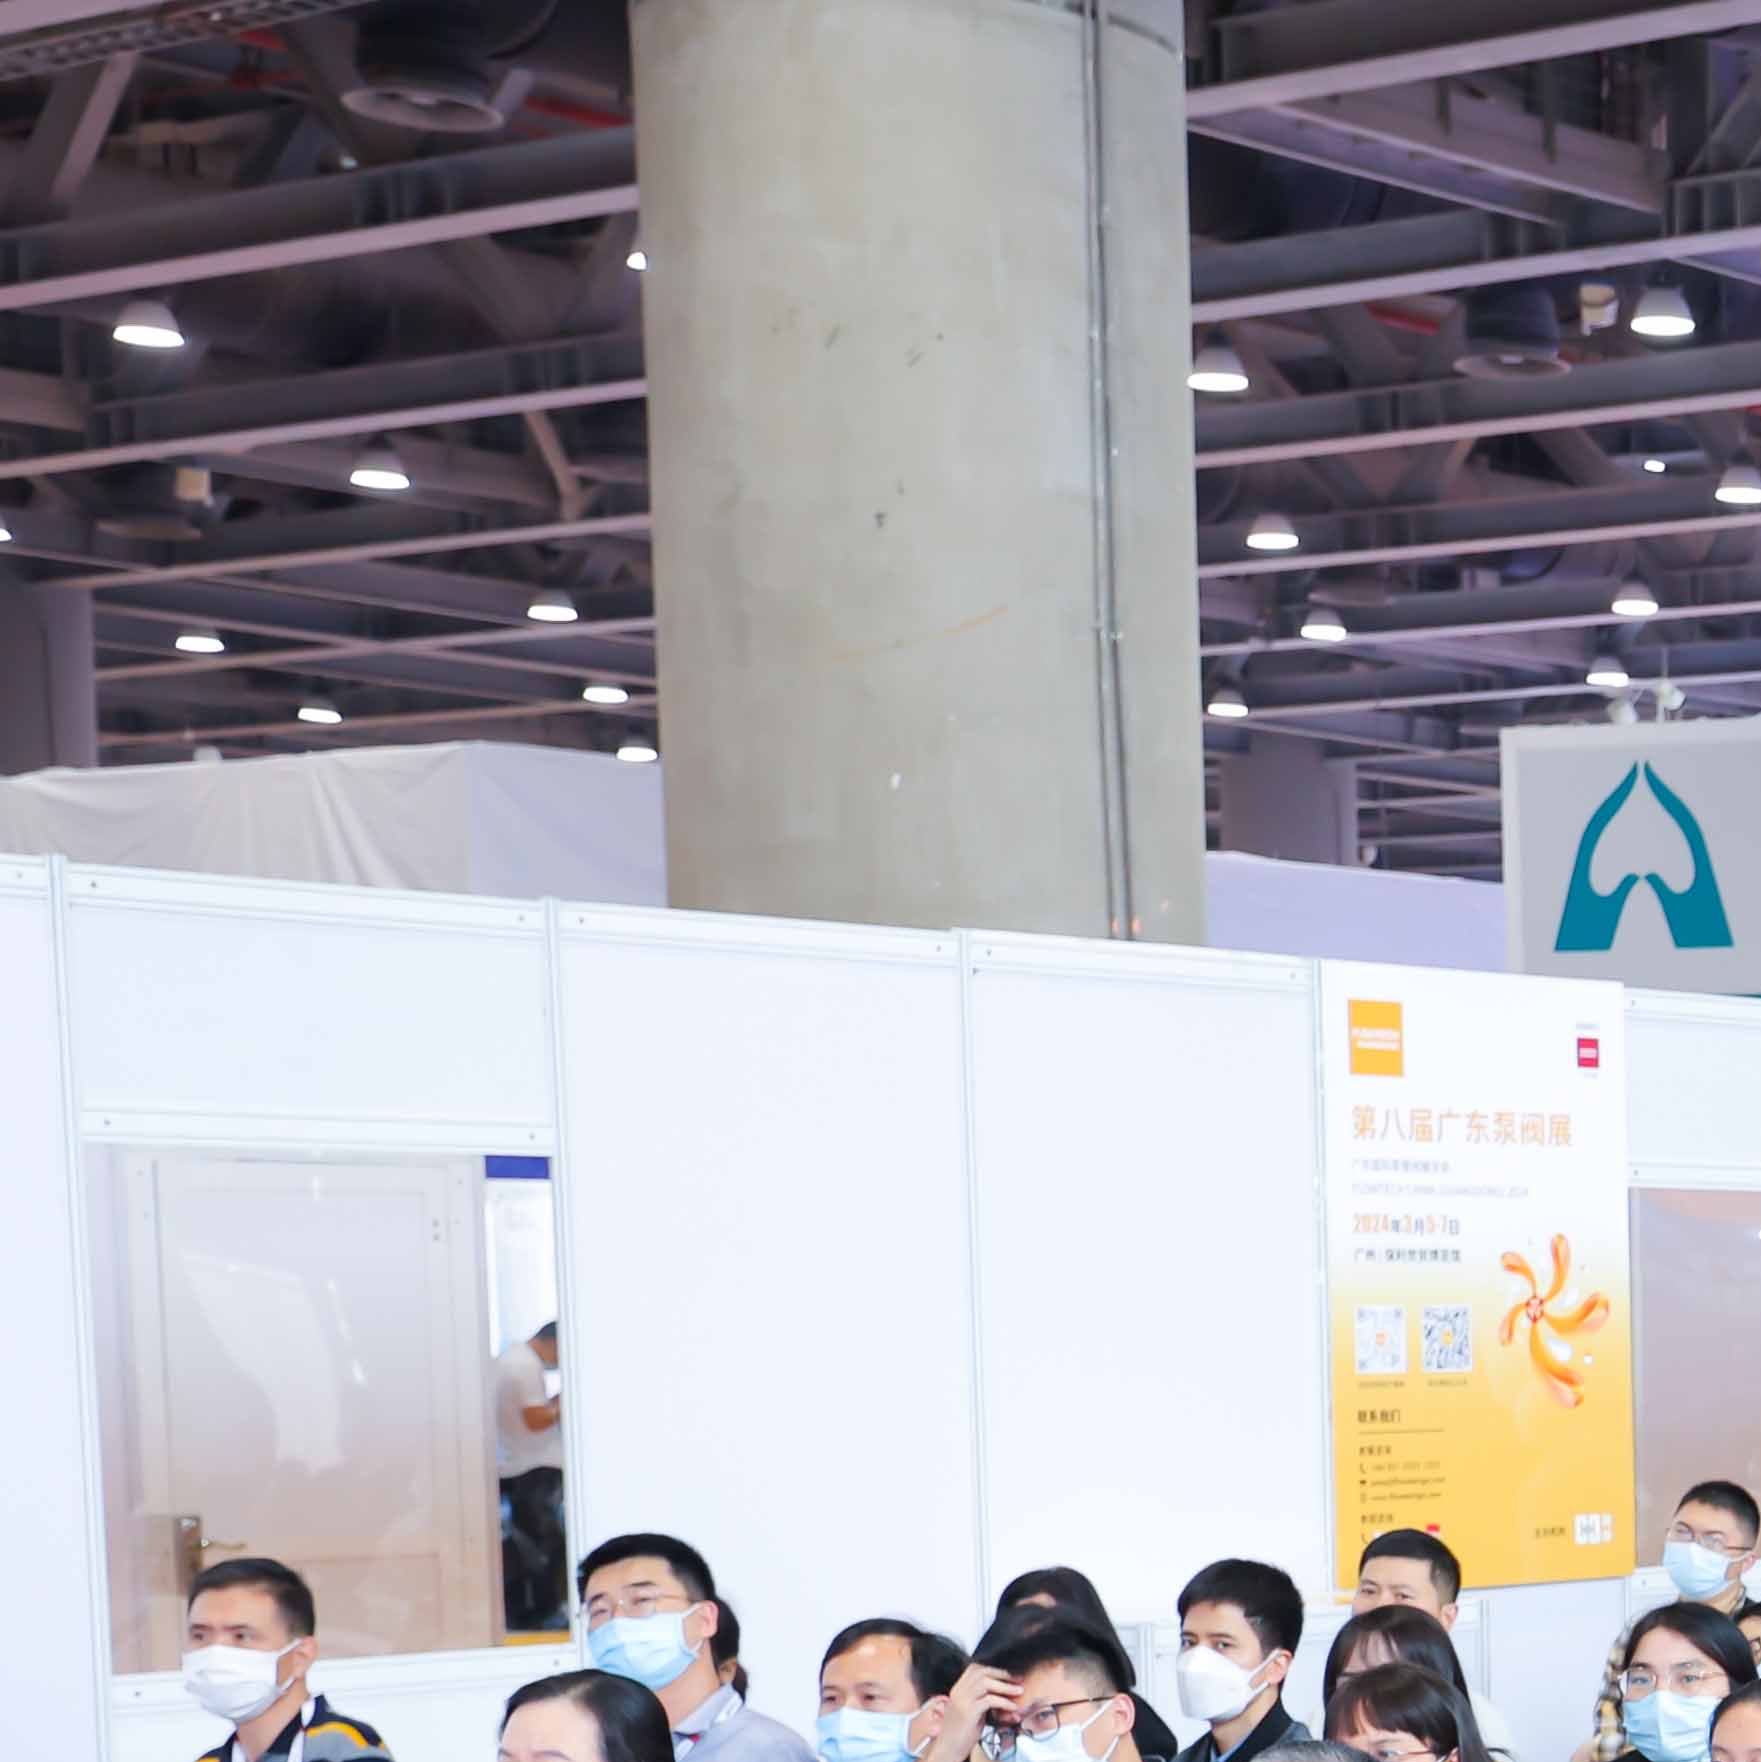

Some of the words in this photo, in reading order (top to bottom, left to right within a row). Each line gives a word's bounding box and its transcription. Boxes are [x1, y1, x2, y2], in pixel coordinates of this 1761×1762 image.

[1352, 1104, 1574, 1147] 第八届广东泵阀展
